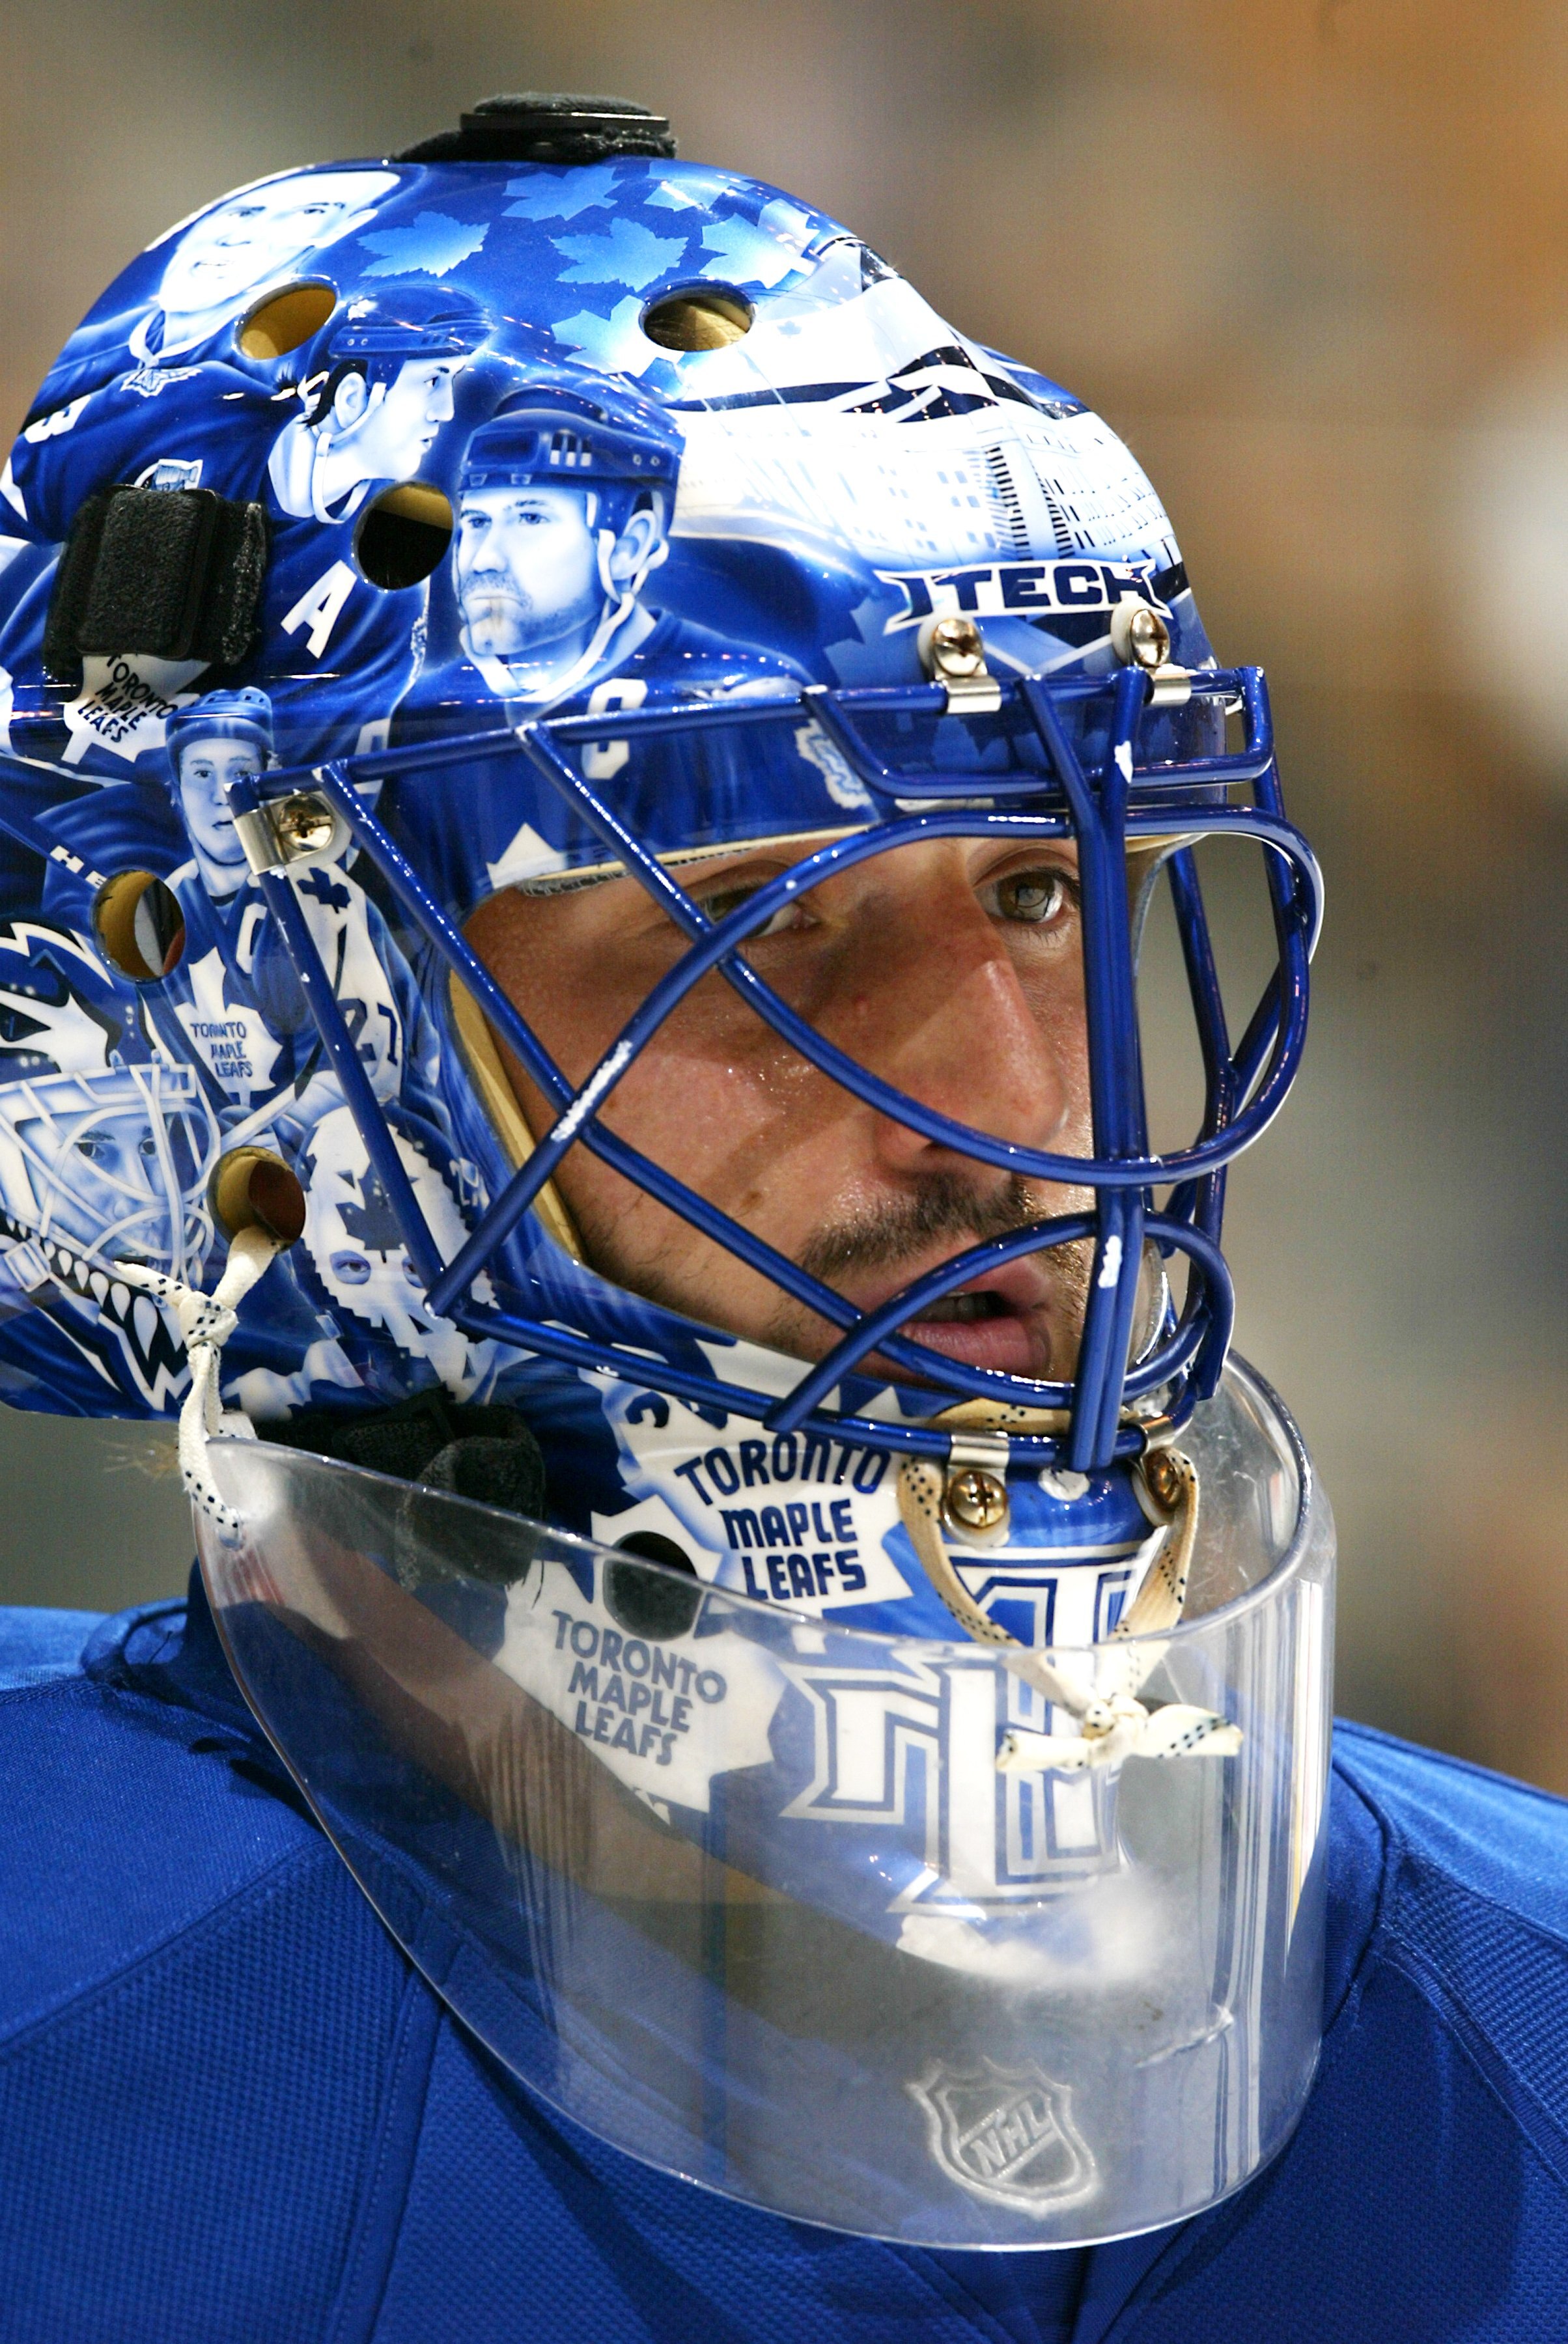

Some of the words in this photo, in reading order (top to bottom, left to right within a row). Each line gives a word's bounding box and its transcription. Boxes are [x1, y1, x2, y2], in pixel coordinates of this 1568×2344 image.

[281, 559, 357, 659] A
[77, 700, 129, 743] LEAFS
[190, 1022, 247, 1039] TORONTO
[215, 1061, 253, 1078] LEAFS
[673, 1432, 891, 1506] TORONTO
[718, 1498, 858, 1550] MAPLE
[741, 1549, 867, 1601] LEAFS
[552, 1610, 727, 1704] TORONTO
[568, 1661, 693, 1733] MAPLE
[575, 1700, 677, 1766] LEAFS
[970, 2100, 1052, 2178] NHL
